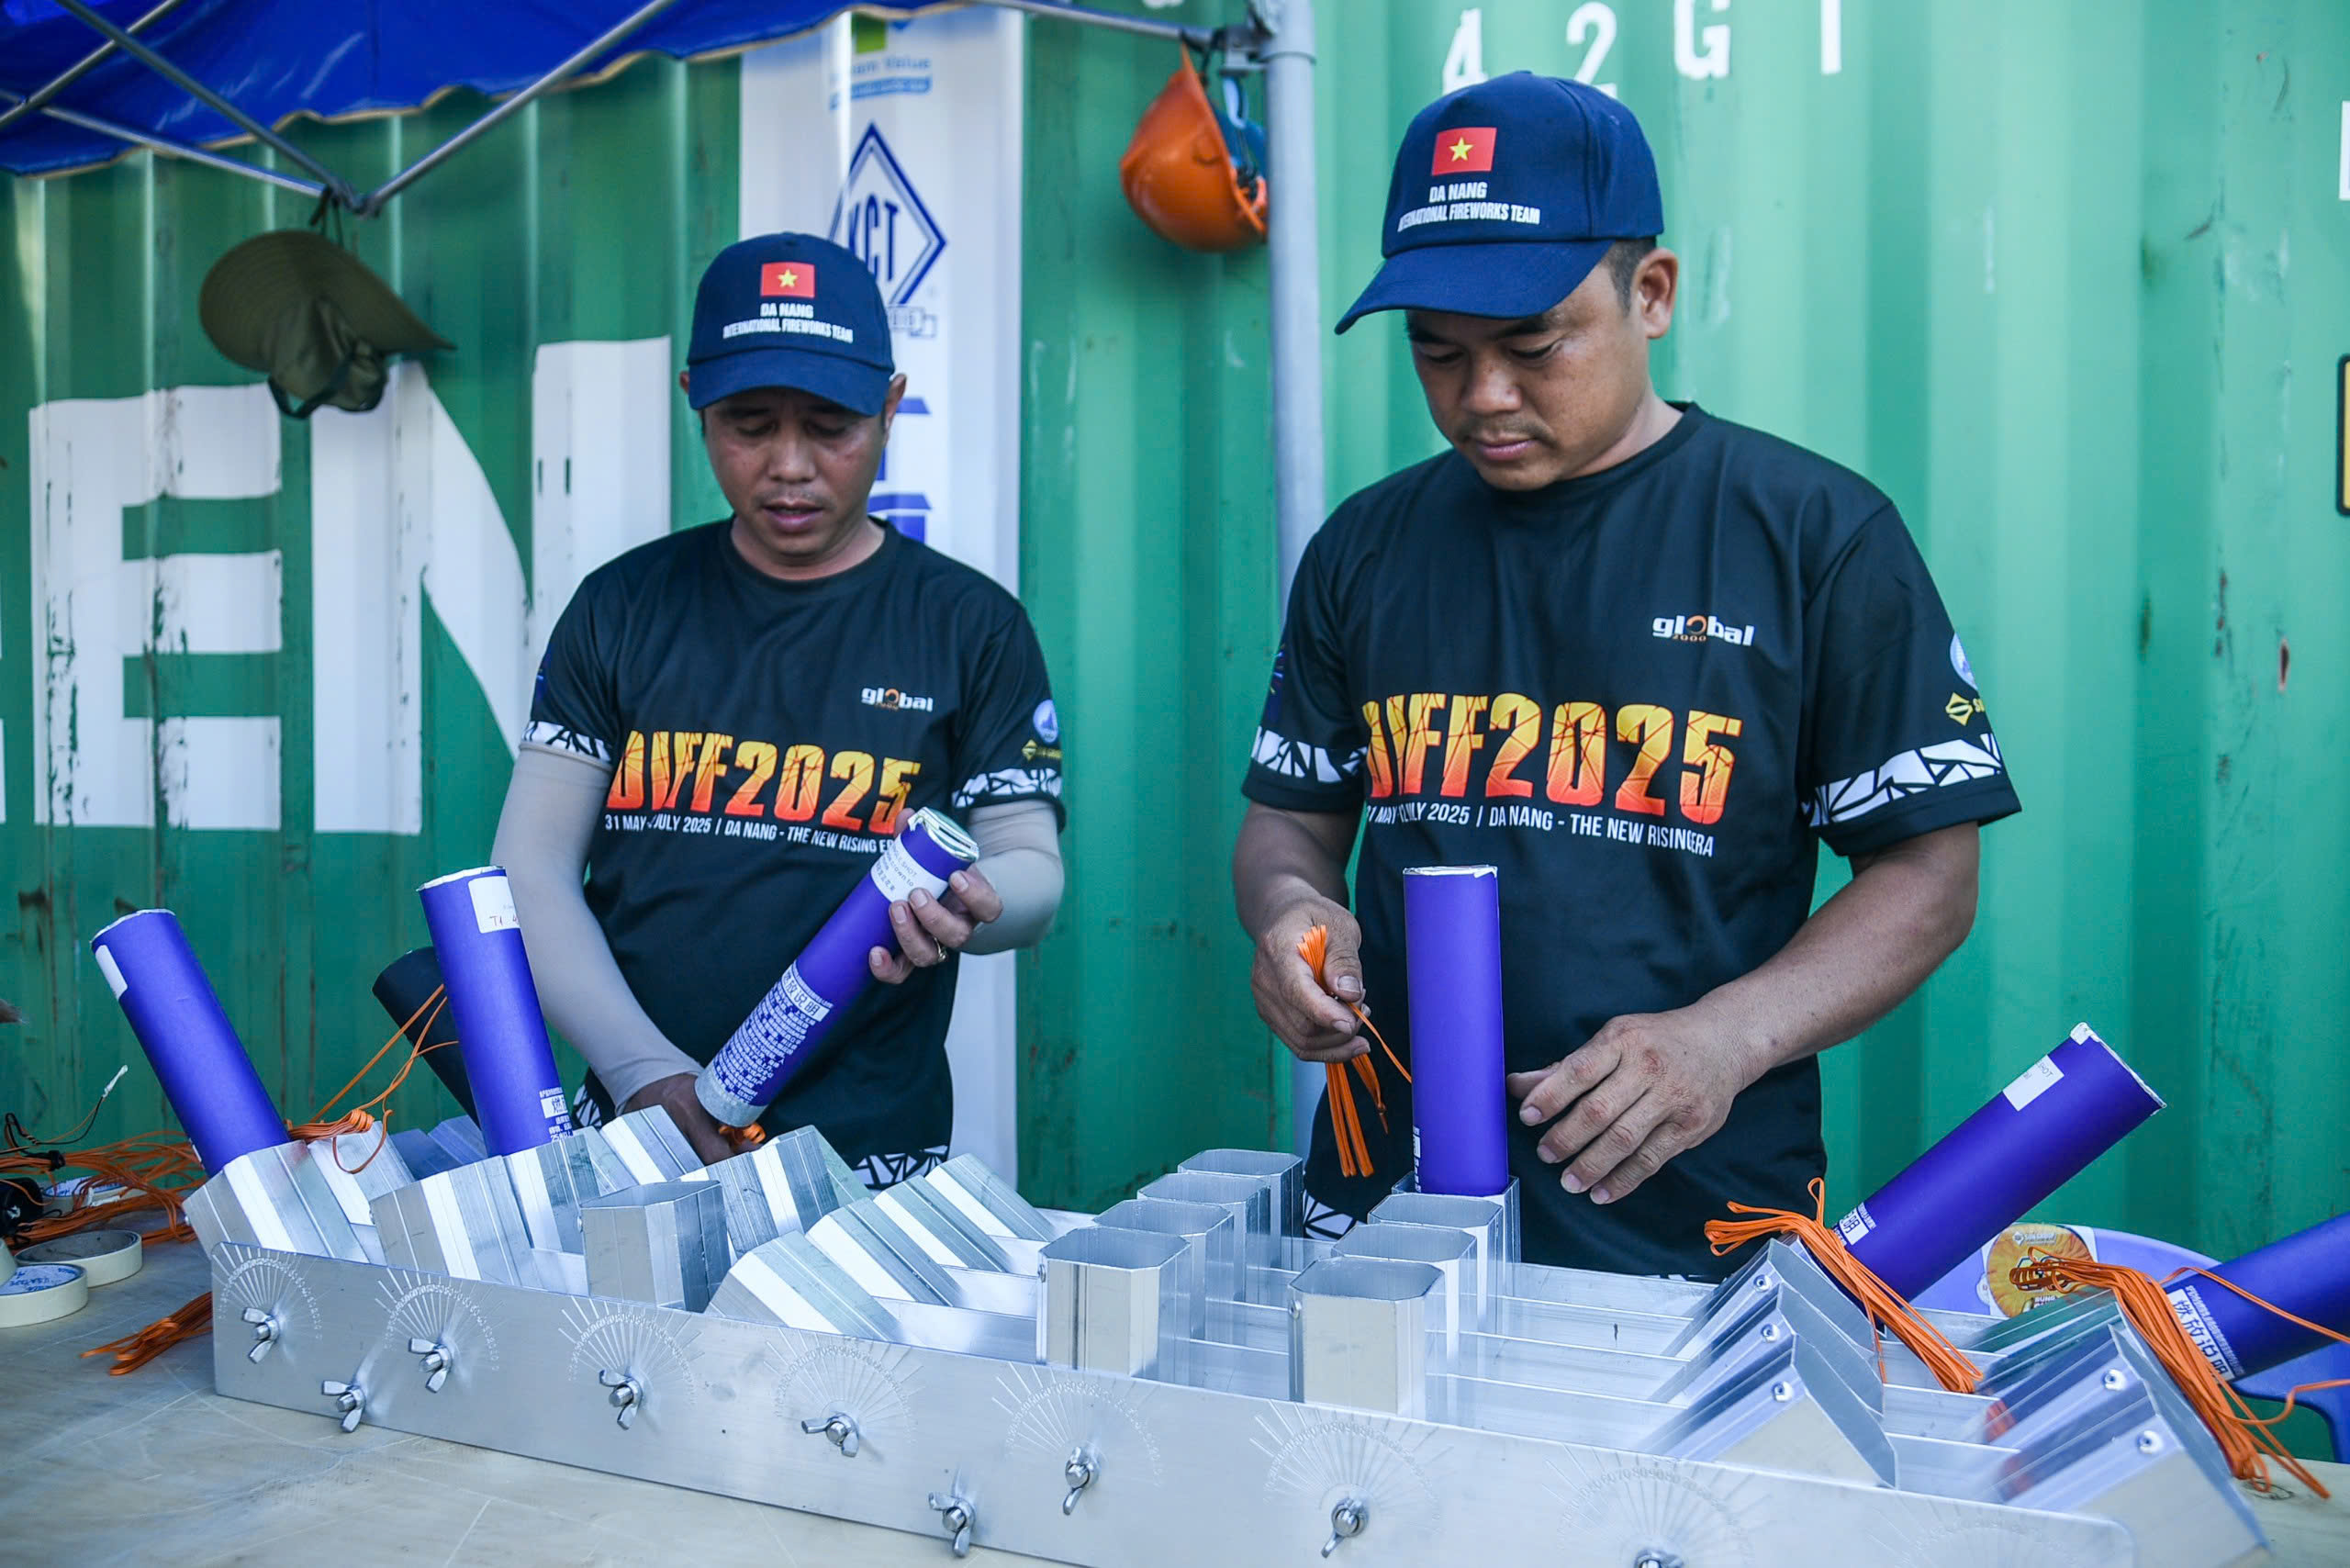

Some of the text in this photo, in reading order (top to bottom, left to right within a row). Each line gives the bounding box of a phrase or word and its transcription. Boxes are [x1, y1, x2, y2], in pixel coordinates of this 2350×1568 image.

[1429, 182, 1488, 203] DA NANG
[1449, 202, 1509, 221] FIREWORKS
[1511, 205, 1540, 225] TEAM
[760, 303, 814, 319] DA NANG
[781, 318, 832, 338] FIREWORKS
[832, 324, 854, 343] TEAM
[0, 335, 670, 835] EN
[1652, 615, 1754, 646] global
[1673, 633, 1707, 642] 2000
[861, 688, 934, 712] global
[605, 730, 921, 834] DIFF2025
[605, 814, 620, 831] 31
[622, 814, 647, 832] MAY
[682, 817, 712, 834] 2025
[724, 820, 741, 836] DA
[743, 822, 778, 841] NANG
[787, 826, 811, 844] THE
[812, 829, 839, 848] NEW
[841, 834, 878, 854] RISING
[1427, 802, 1471, 824] 2025
[1489, 806, 1506, 826] DA
[1509, 806, 1553, 831] NANG
[1571, 813, 1603, 837] THE
[1607, 818, 1644, 845] NEW
[1691, 832, 1714, 857] ERA
